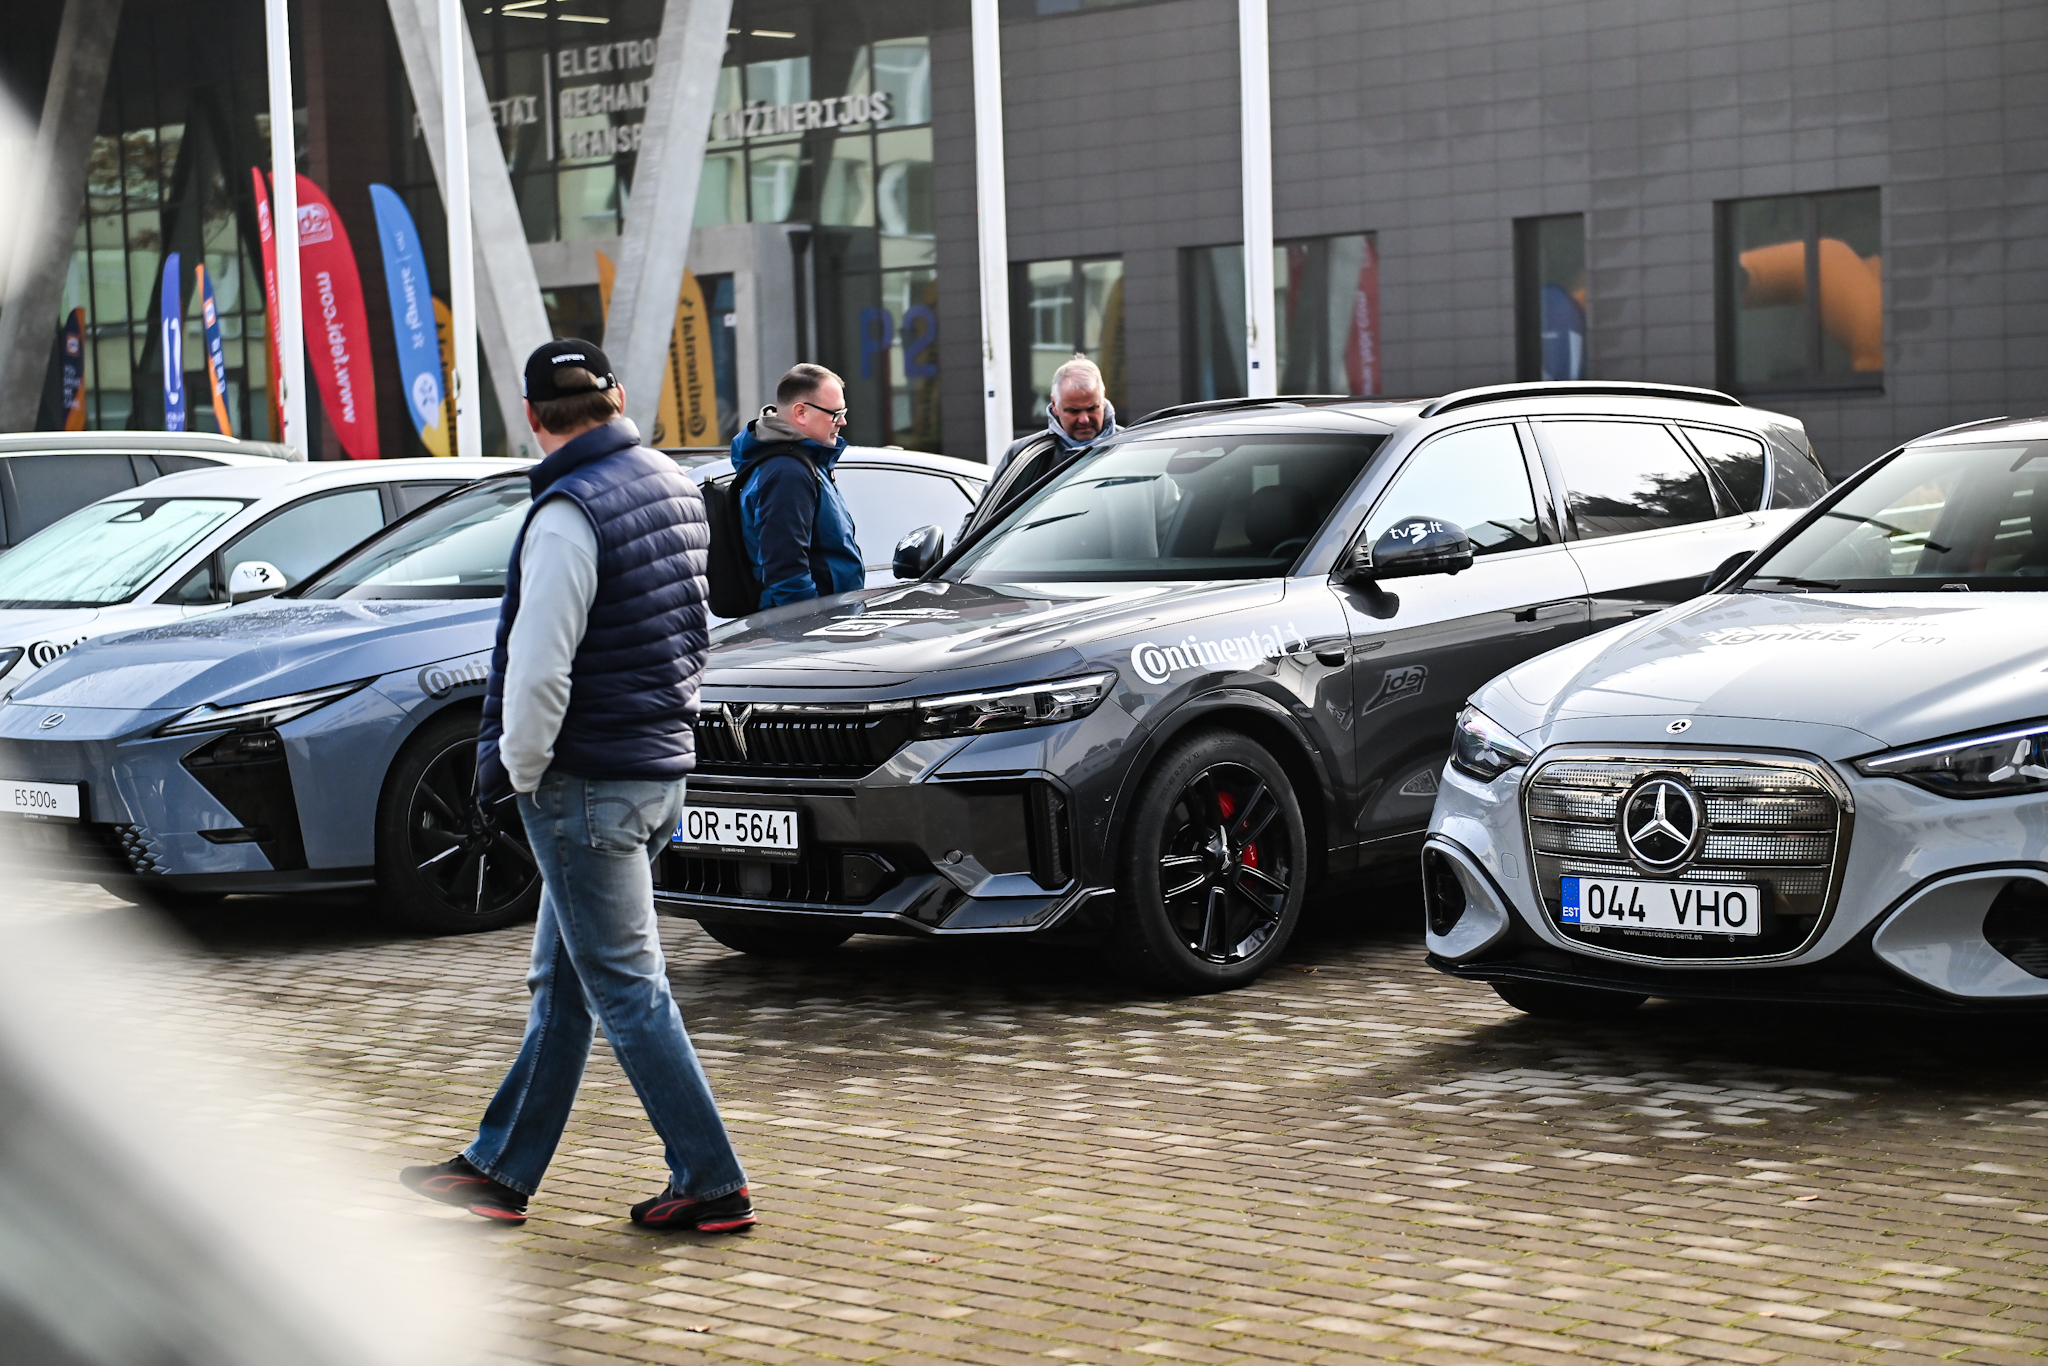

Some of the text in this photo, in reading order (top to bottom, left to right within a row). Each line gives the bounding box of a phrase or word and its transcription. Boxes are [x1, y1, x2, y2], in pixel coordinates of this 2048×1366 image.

[562, 124, 642, 158] TRANSP
[860, 305, 938, 379] P2
[1389, 521, 1444, 545] tv3.lt
[1130, 625, 1289, 685] Continental
[29, 790, 57, 809] 500e
[1562, 906, 1580, 918] EST
[1588, 884, 1747, 927] 044 VHO
[1623, 928, 1703, 941] www.mercedes-benz.ee
